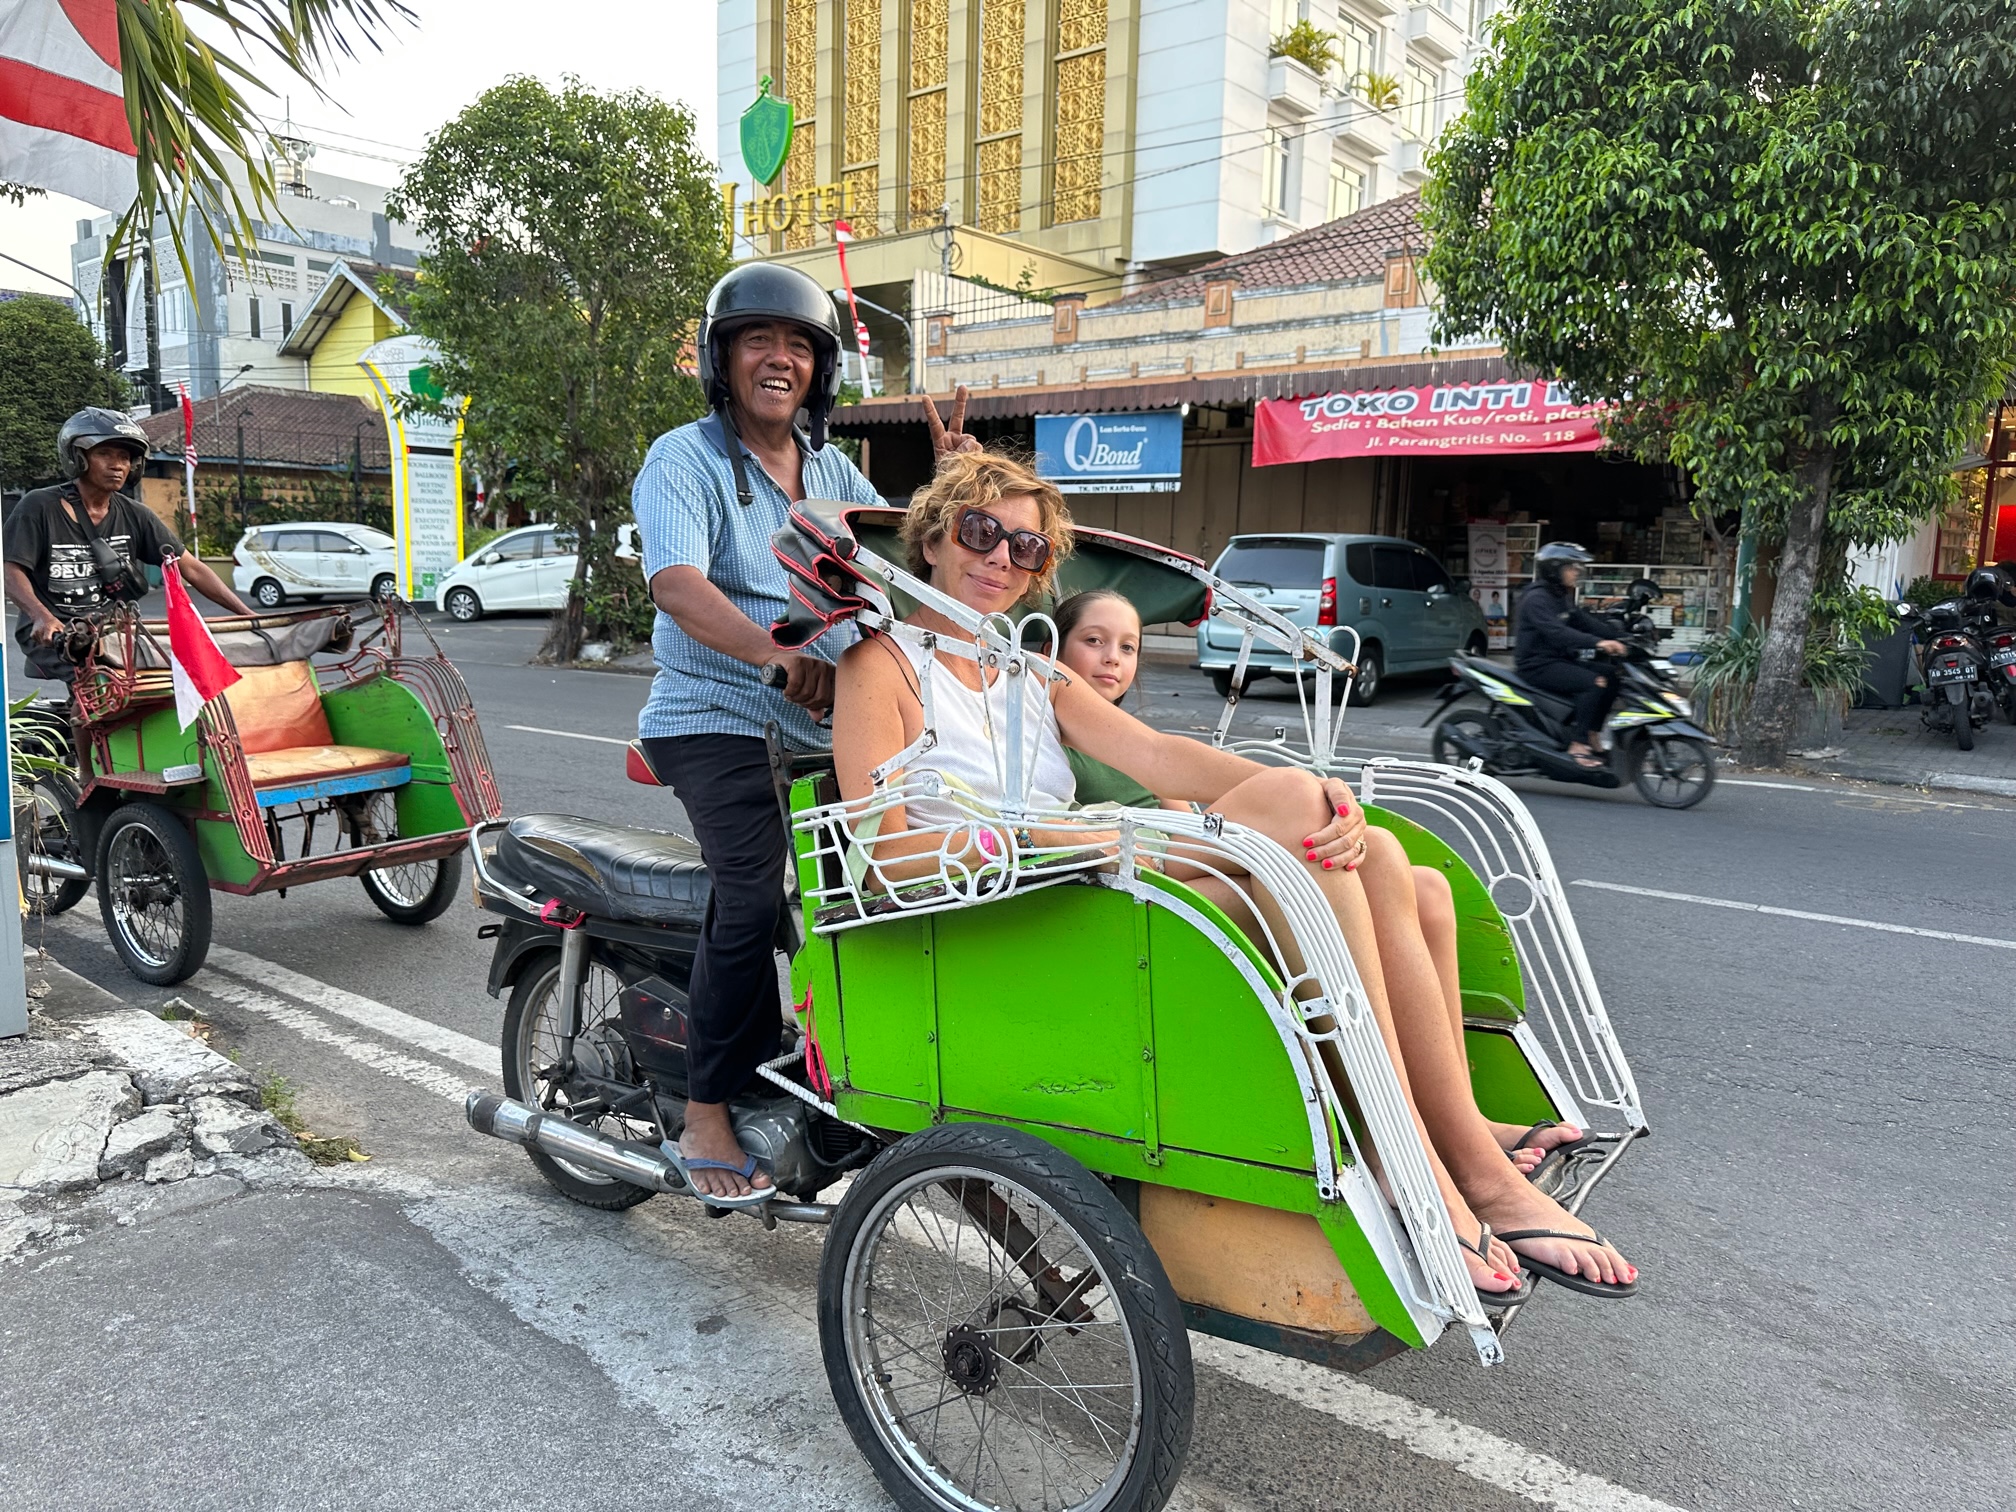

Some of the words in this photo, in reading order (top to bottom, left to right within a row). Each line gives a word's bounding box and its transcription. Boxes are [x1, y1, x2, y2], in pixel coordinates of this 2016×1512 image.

[743, 180, 864, 237] HOTEL
[1300, 391, 1419, 421] TOKO
[1430, 383, 1532, 412] INTI
[1311, 418, 1360, 434] Sedia
[1376, 416, 1438, 430] Bahan
[1443, 409, 1540, 426] Kue/roti,
[1365, 436, 1384, 449] Jl.
[1389, 433, 1495, 449] Parangtritis
[1500, 432, 1531, 444] No.
[1542, 430, 1576, 443] 118
[1109, 484, 1135, 492] KARYA
